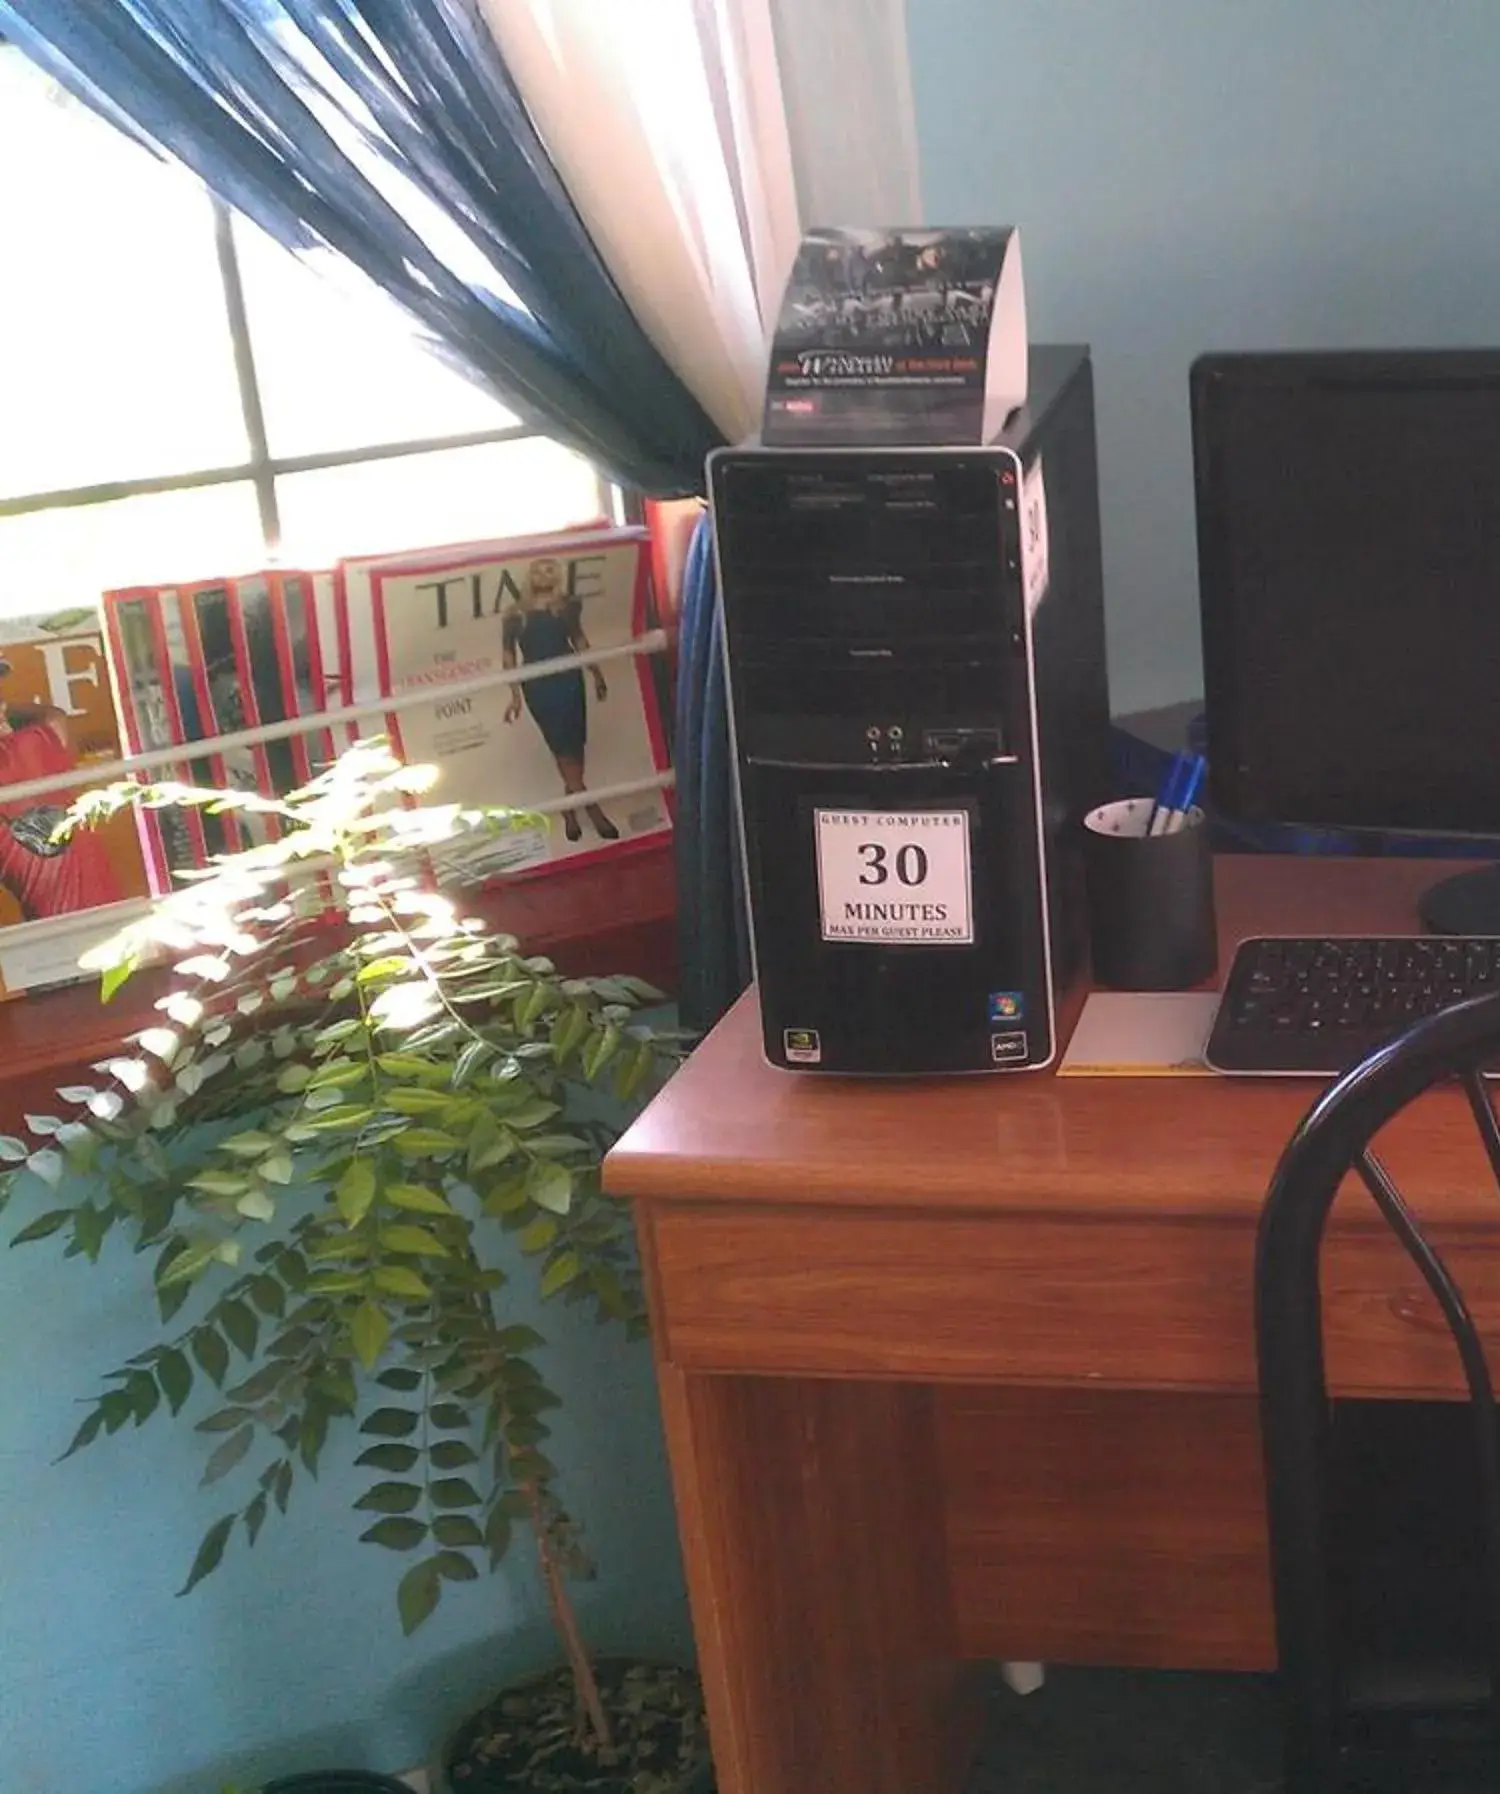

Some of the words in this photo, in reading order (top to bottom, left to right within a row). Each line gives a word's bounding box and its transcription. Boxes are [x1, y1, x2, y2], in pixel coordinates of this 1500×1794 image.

[821, 816, 868, 826] GUEST
[877, 816, 961, 826] COMPUTER
[857, 843, 928, 886] 30
[844, 903, 948, 921] MINUTES
[829, 925, 855, 935] MAX
[857, 926, 879, 935] PER
[882, 926, 919, 936] GUEST
[921, 927, 964, 937] PLEASE
